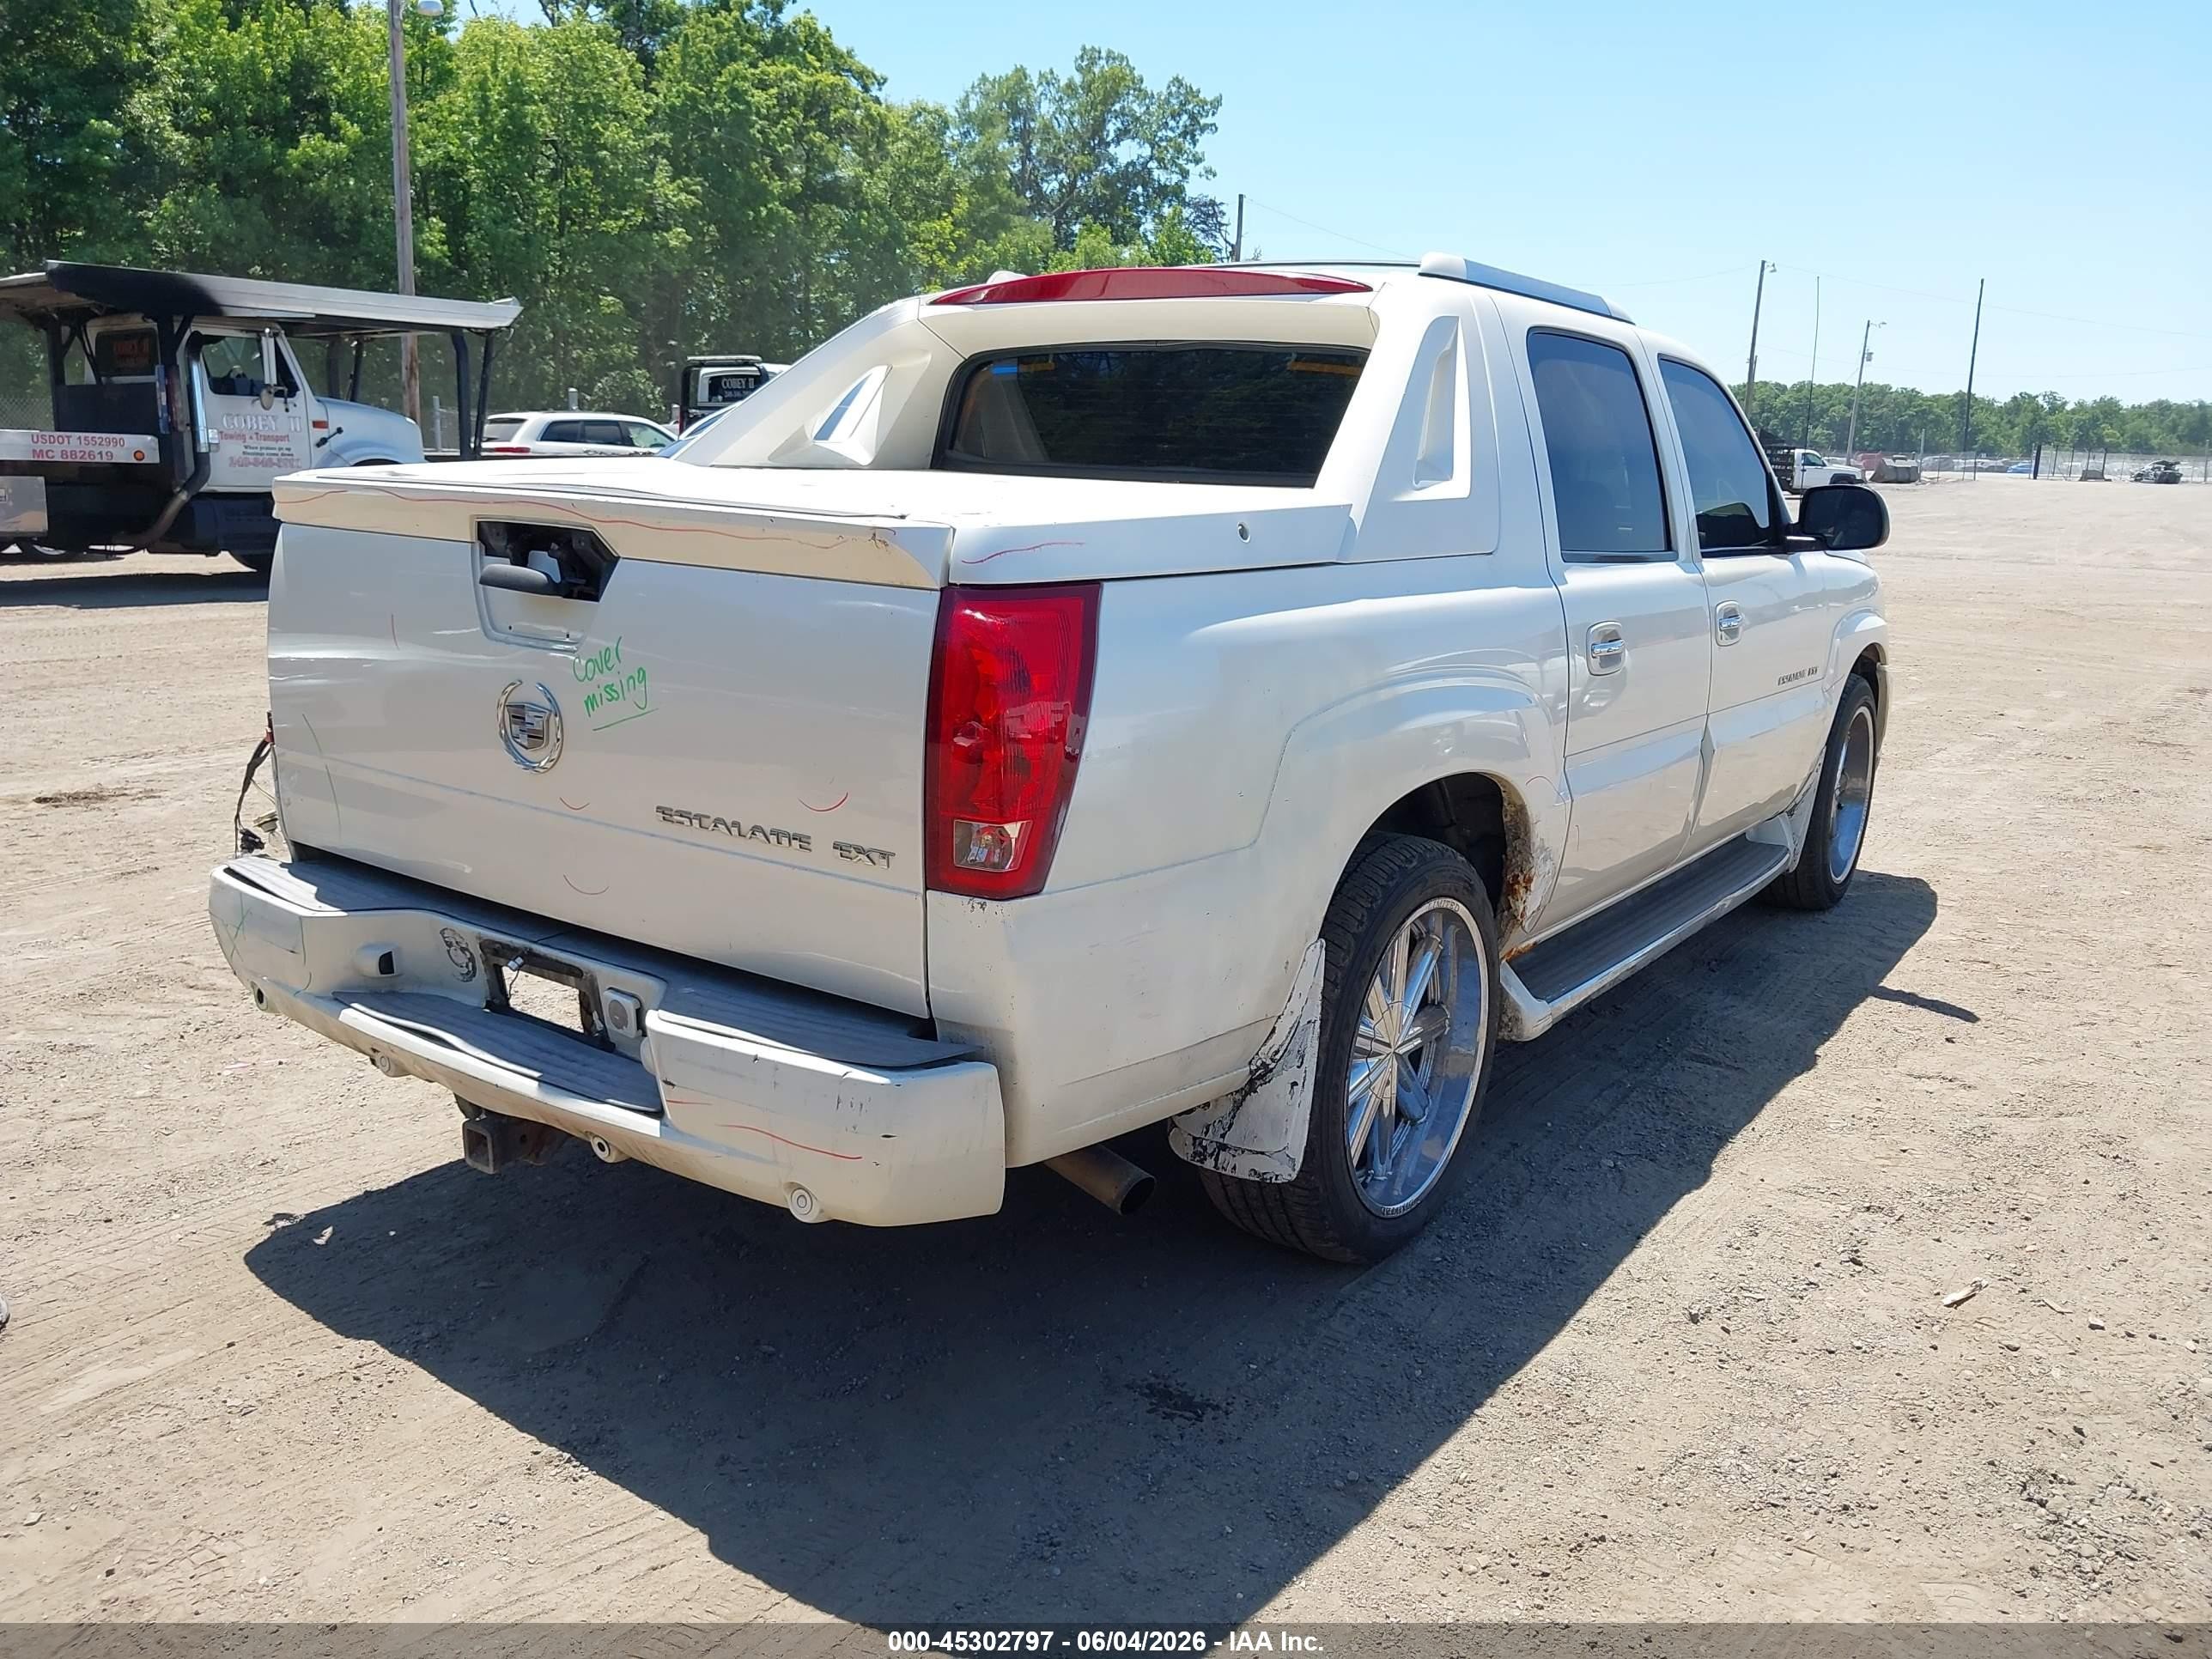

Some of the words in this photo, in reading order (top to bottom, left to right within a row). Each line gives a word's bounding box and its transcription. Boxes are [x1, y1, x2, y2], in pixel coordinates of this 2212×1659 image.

[222, 413, 278, 430] COBEY
[31, 434, 71, 446] USDOT
[76, 435, 125, 447] 1552990
[32, 449, 56, 459] MC
[60, 449, 114, 461] 882619
[584, 666, 647, 718] missing
[655, 805, 812, 853] ESCALADE
[832, 841, 896, 869] EXT
